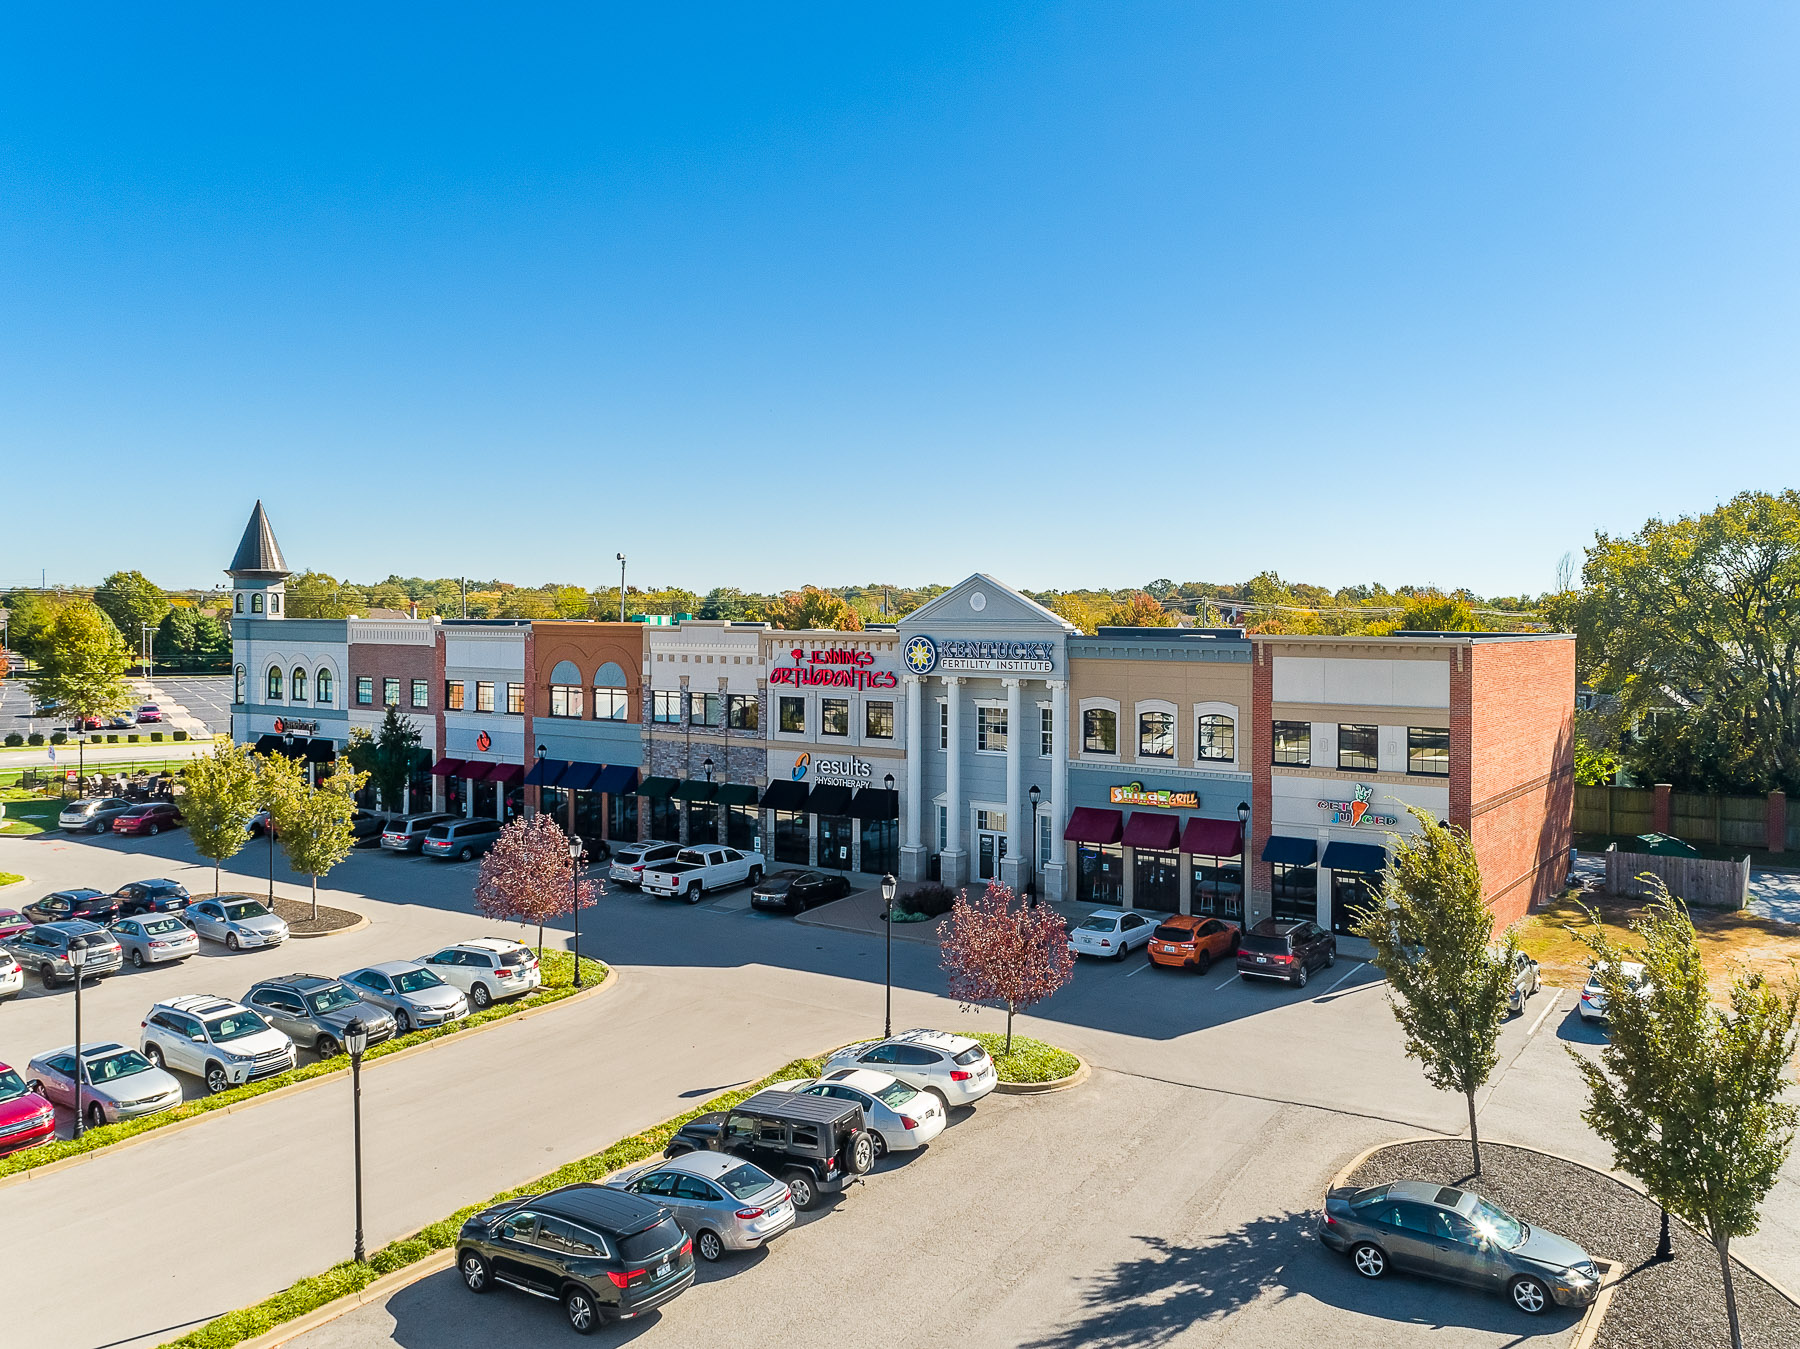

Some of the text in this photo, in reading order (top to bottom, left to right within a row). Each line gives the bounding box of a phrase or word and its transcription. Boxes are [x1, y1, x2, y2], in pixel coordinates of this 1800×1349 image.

[807, 648, 874, 668] JENNINGS
[940, 641, 1054, 660] KENTUCKY
[942, 660, 1050, 671] FERTILITY INSTITUTE
[770, 665, 897, 691] ORTHODONTICS
[814, 755, 871, 777] results
[814, 776, 870, 789] PHYSIOTHERAPY
[1114, 788, 1168, 802] Shiraz
[1168, 793, 1198, 805] GRILL
[1317, 801, 1349, 812] GET
